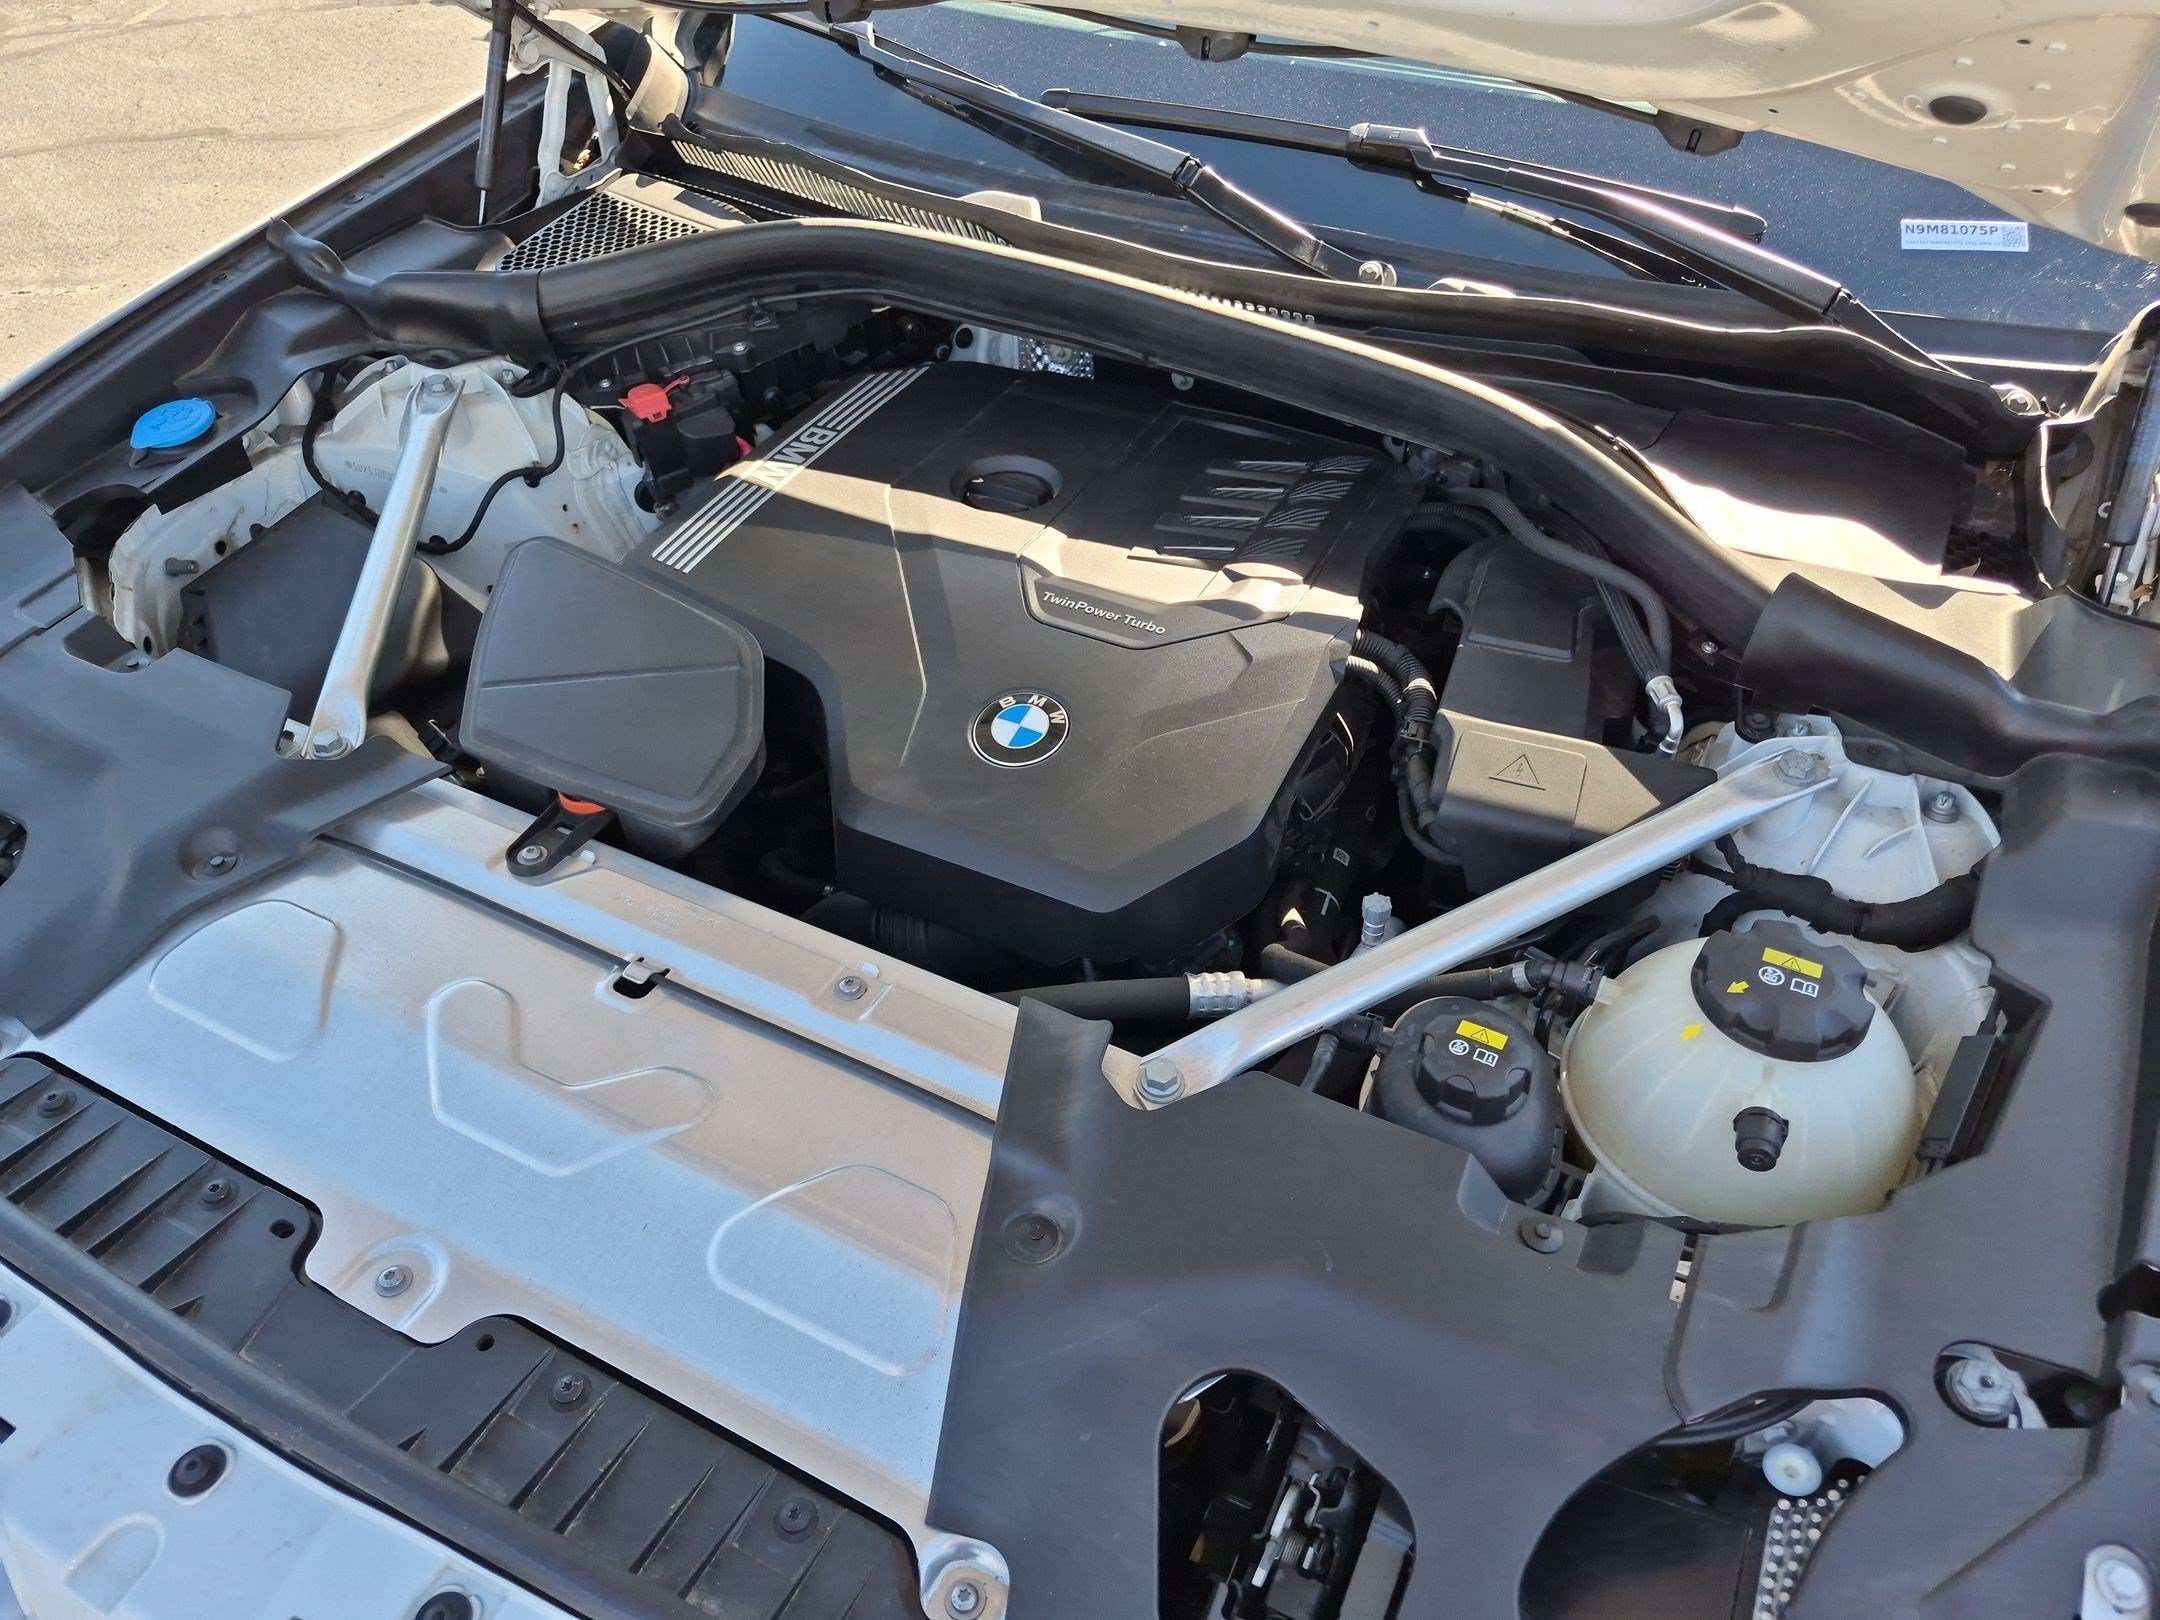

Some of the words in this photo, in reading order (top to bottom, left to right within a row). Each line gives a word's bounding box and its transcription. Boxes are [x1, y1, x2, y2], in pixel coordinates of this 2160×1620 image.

[1904, 224, 1999, 236] N9M81075P
[751, 426, 839, 488] BMW
[1042, 591, 1122, 622] TwinPower
[1123, 613, 1167, 635] Turbo
[998, 694, 1066, 724] BMW
